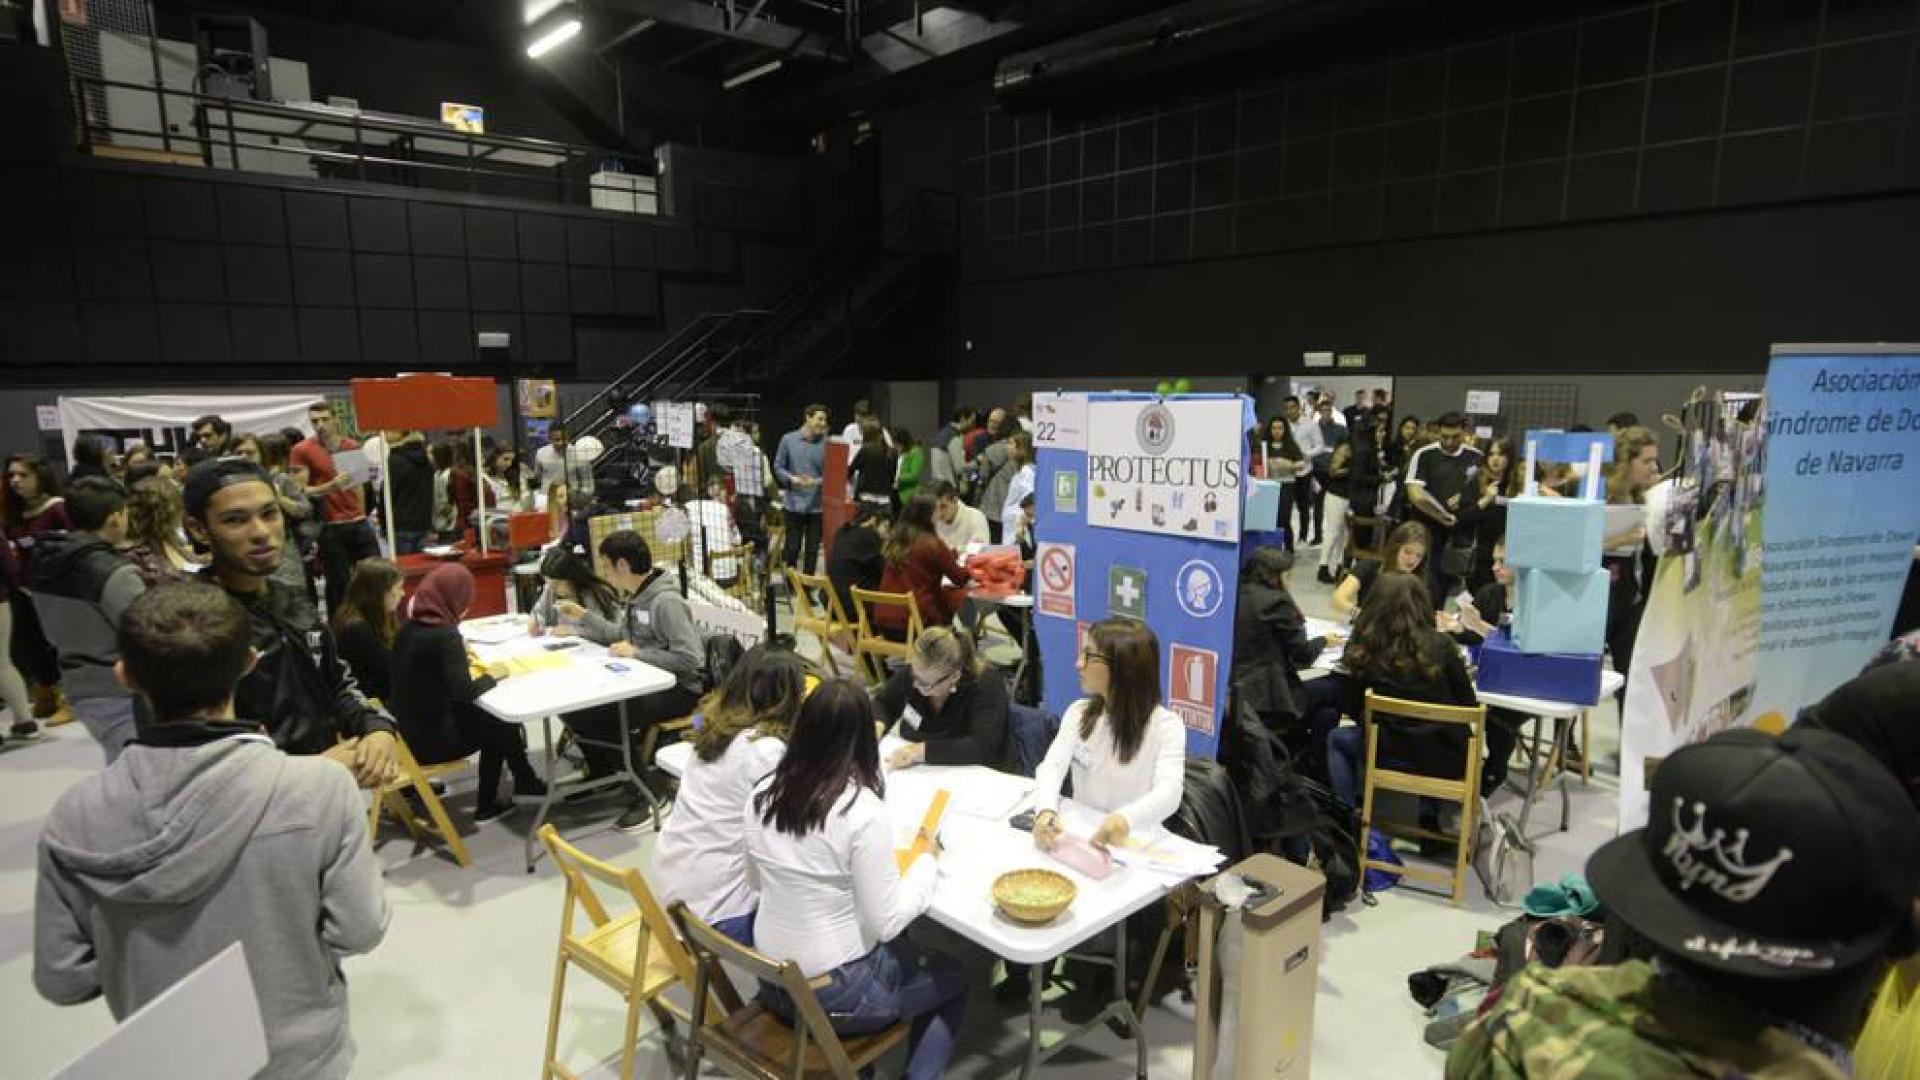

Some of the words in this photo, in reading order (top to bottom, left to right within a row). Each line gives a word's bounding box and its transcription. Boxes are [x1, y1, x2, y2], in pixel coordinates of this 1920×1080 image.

[1810, 367, 1920, 393] Asociación
[1036, 420, 1056, 441] 22
[1766, 409, 1860, 436] índrome
[1866, 407, 1894, 433] de
[1088, 454, 1240, 489] PROTECTUS
[1795, 449, 1822, 476] de
[1826, 450, 1904, 474] Navarra
